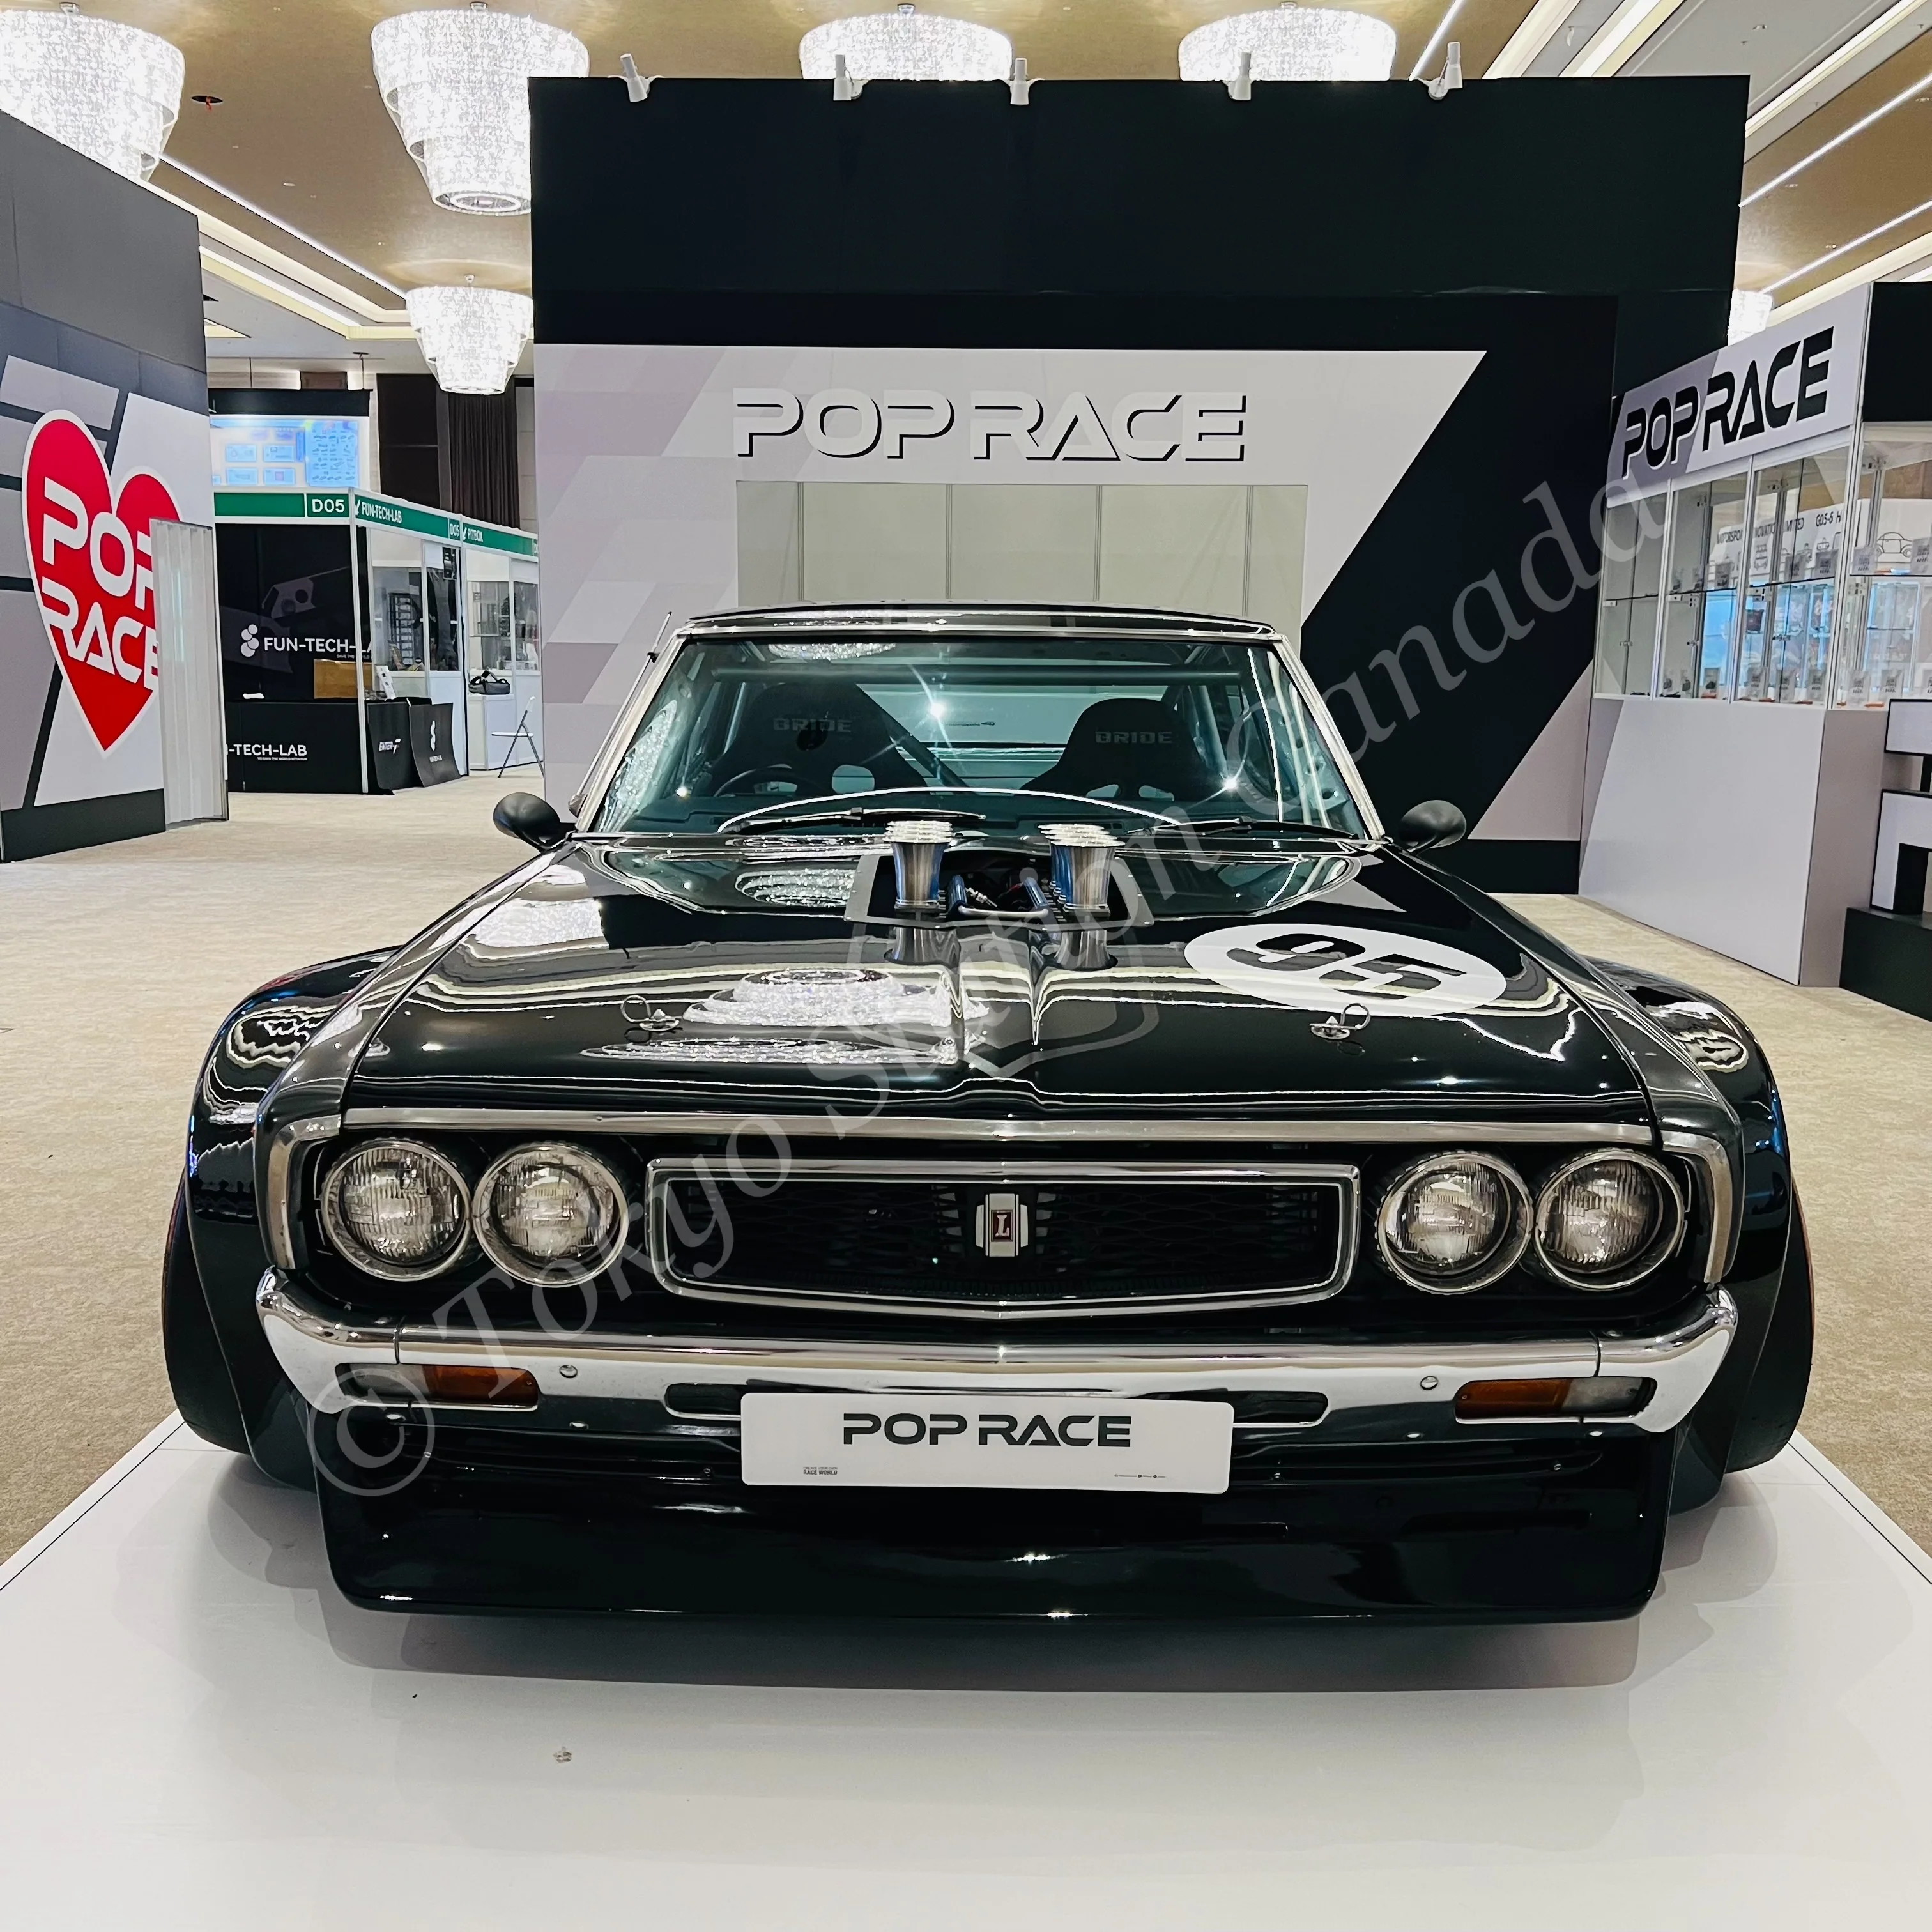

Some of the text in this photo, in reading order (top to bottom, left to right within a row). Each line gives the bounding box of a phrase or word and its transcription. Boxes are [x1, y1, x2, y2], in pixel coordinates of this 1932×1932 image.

[1622, 326, 1835, 480] POP RACE
[733, 387, 1247, 463] POP RACE
[312, 499, 345, 513] D05
[362, 502, 402, 524] FUN-TECH-LAB
[264, 637, 371, 652] FUN-TECH-
[773, 718, 853, 733] BRIDE
[1095, 731, 1173, 744] BRIDE
[226, 744, 307, 756] -TECH-LAB
[1226, 933, 1468, 1000] 95
[843, 1413, 1132, 1447] POP RACE
